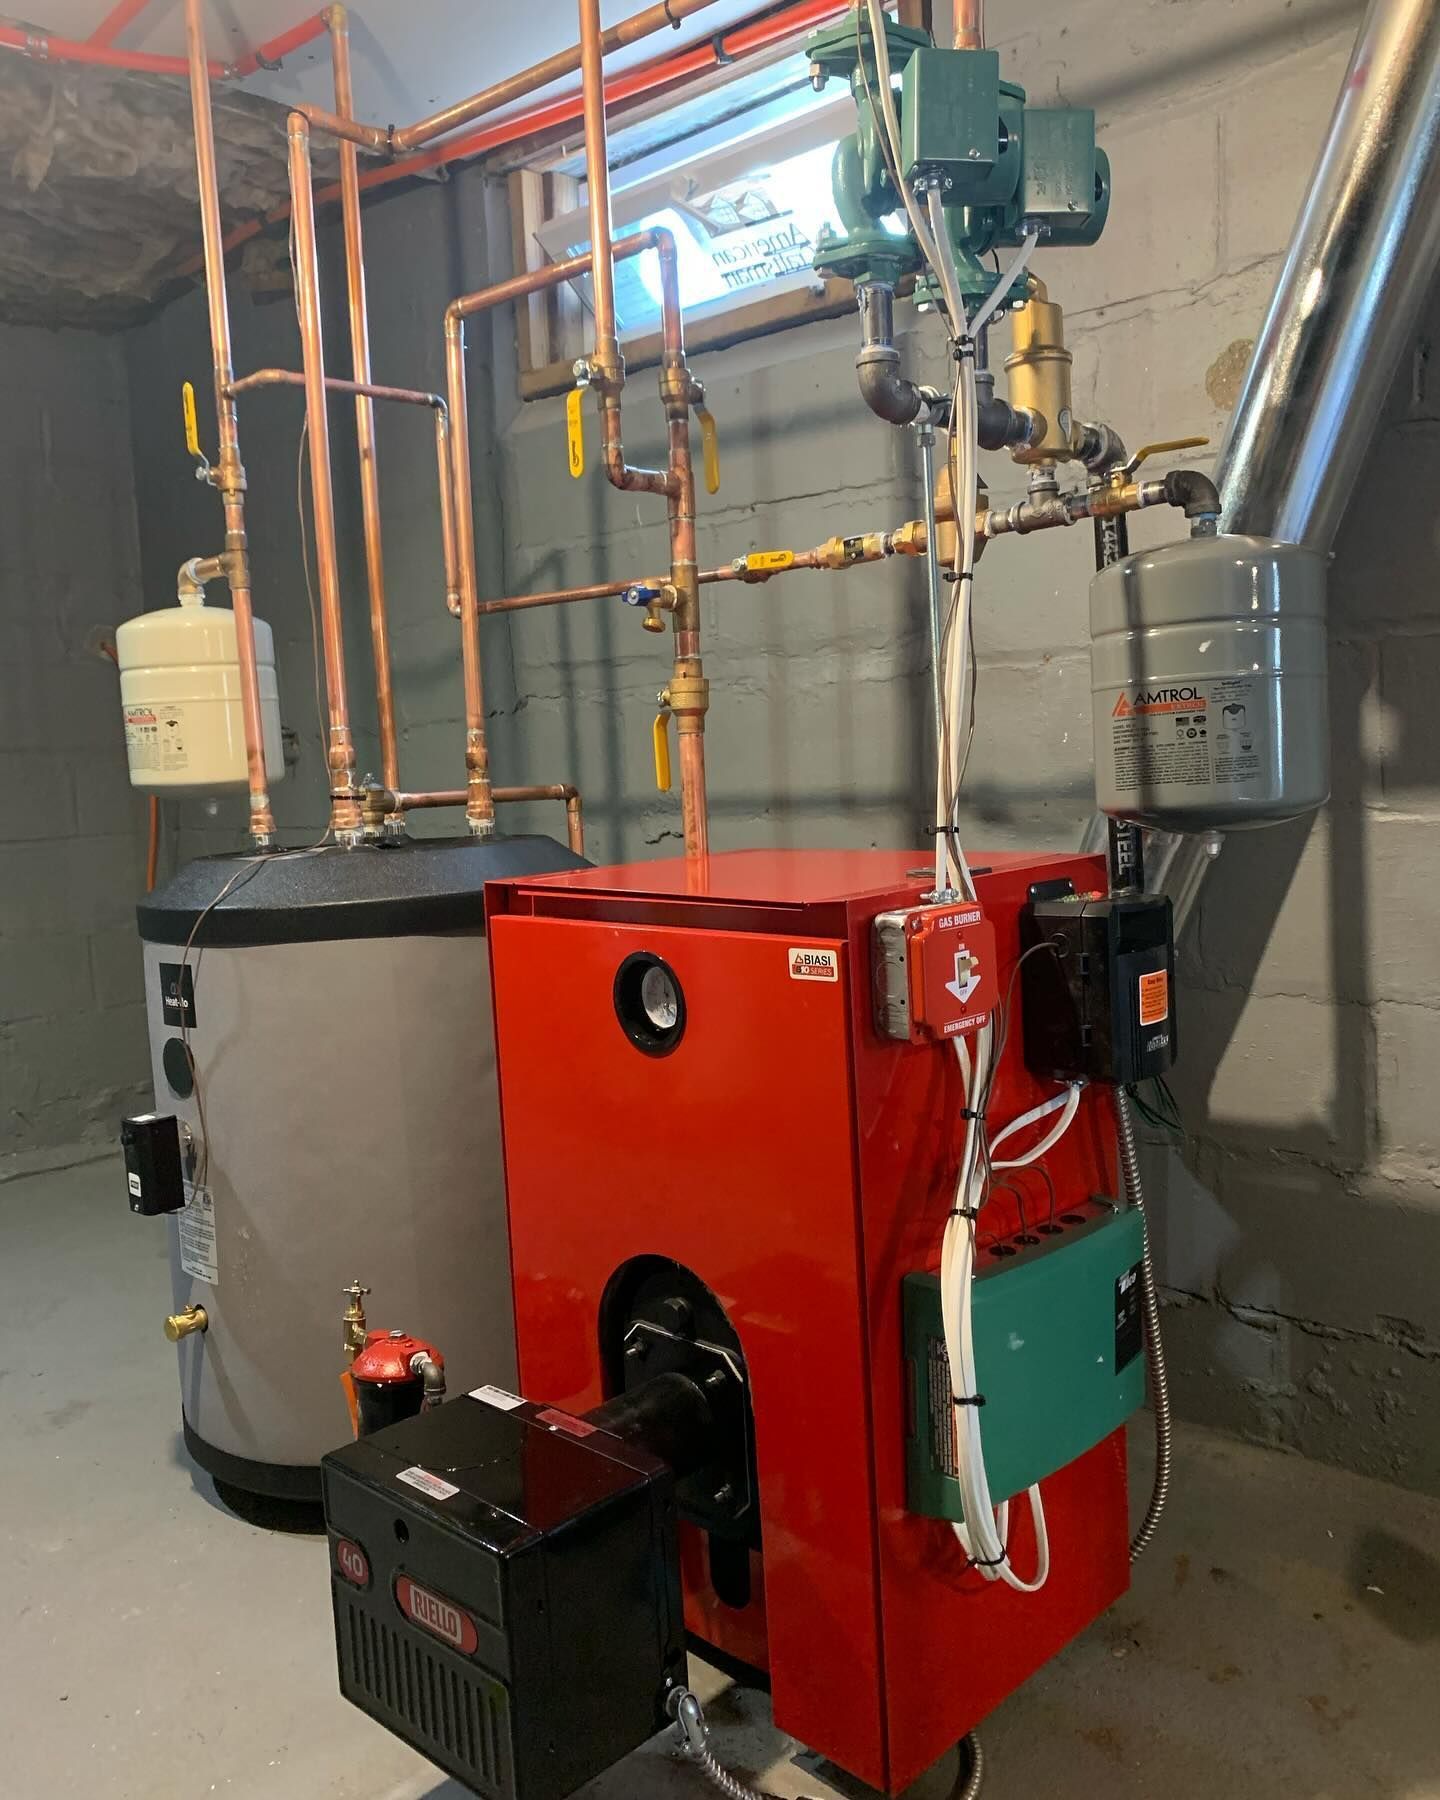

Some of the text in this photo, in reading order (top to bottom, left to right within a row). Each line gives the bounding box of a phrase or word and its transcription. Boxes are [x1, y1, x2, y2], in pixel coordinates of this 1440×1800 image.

[1134, 687, 1203, 705] AMTROL
[939, 911, 980, 929] GAS BURNER
[804, 954, 830, 965] BIASI
[811, 967, 832, 975] SERIES
[944, 1014, 985, 1033] EMERGENCY OFF
[343, 1548, 363, 1577] 40
[414, 1589, 458, 1638] RIELLO
